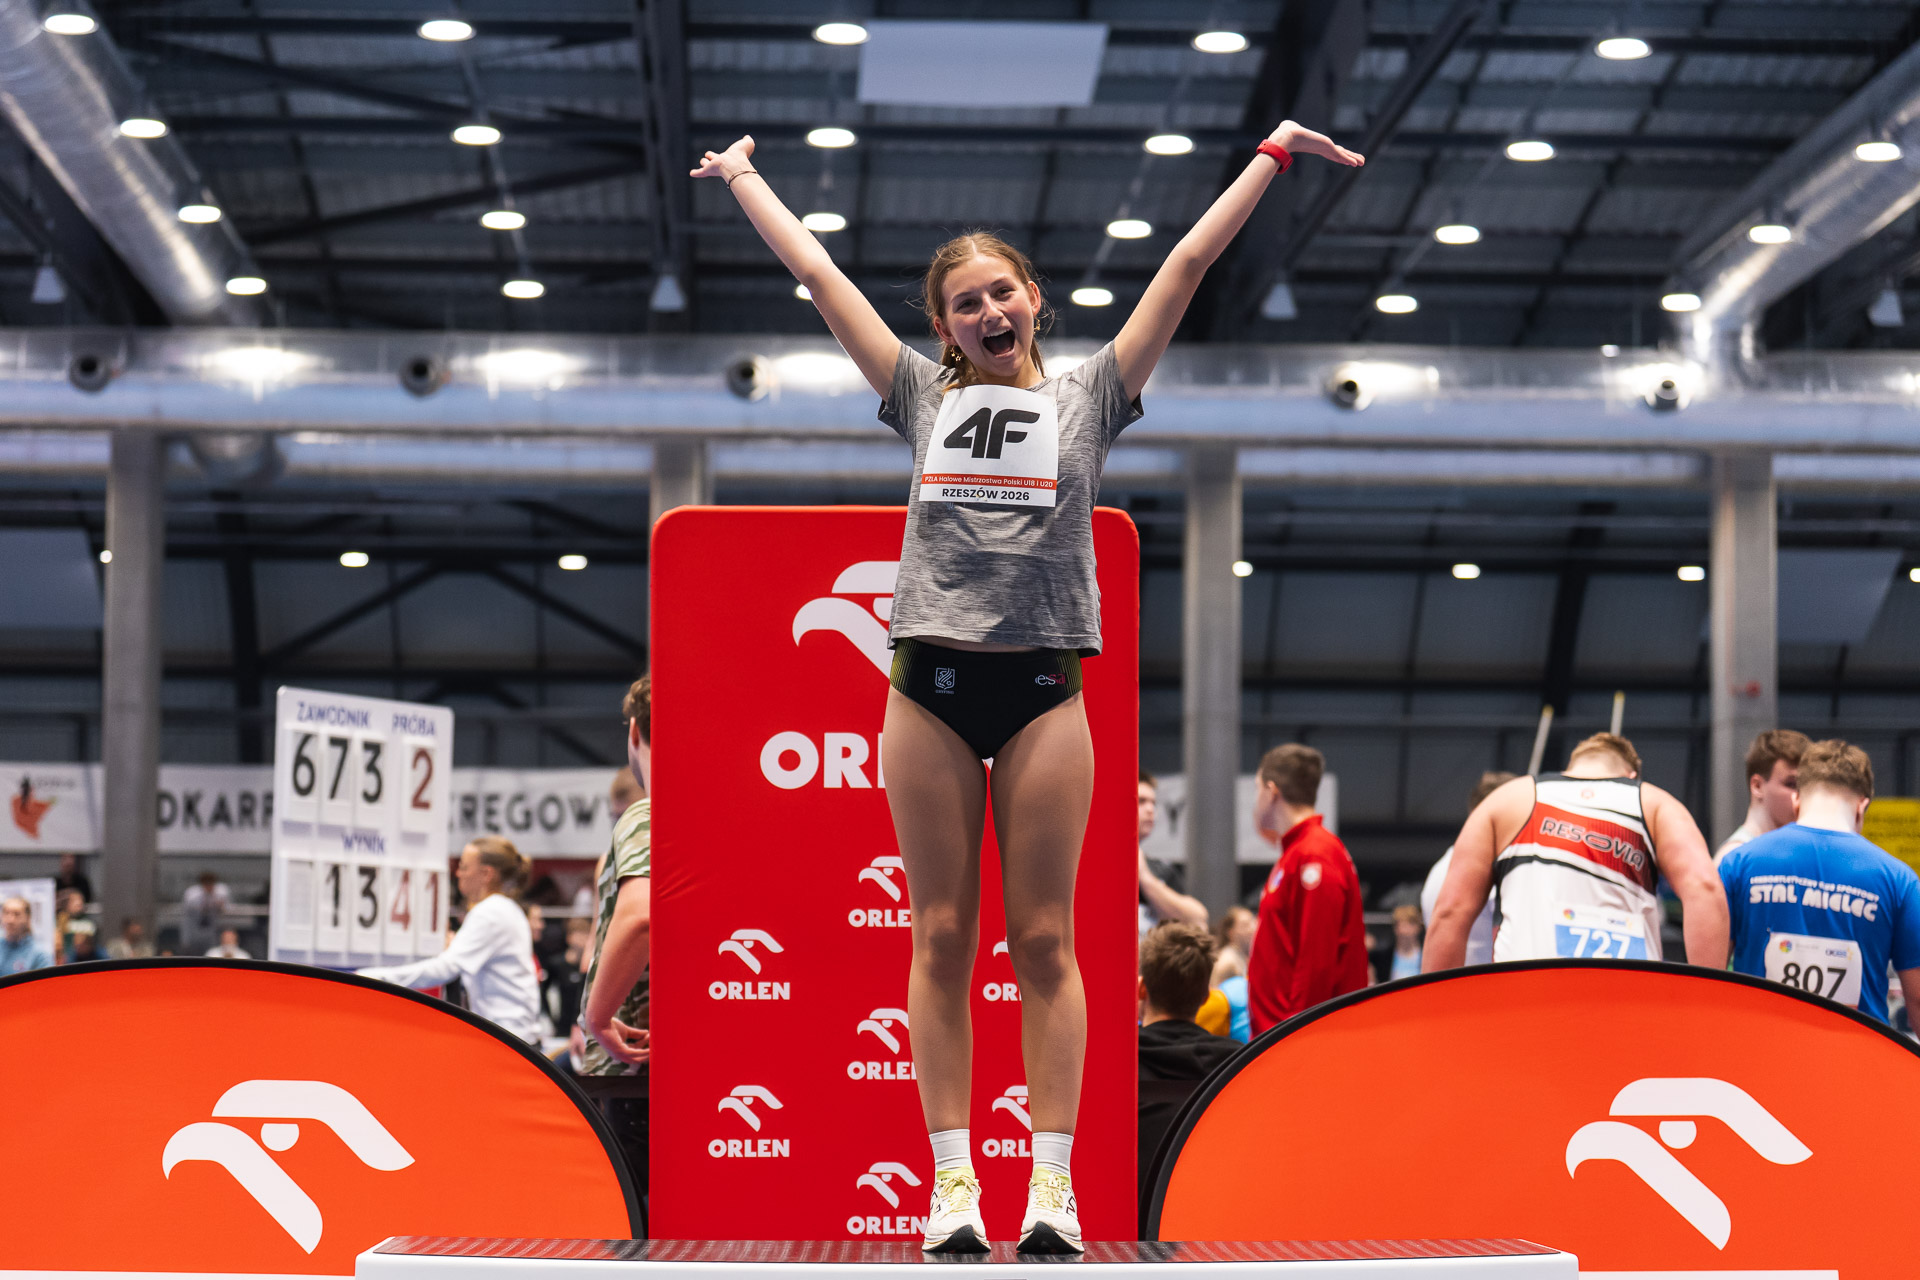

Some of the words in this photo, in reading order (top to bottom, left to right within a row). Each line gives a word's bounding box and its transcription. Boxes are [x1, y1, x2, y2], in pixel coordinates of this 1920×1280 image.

[943, 407, 1040, 460] 4F
[1003, 478, 1023, 486] Polski
[942, 487, 998, 499] RZESZÓW
[1001, 490, 1030, 501] 2026
[760, 731, 886, 789] OR
[412, 747, 433, 810] 2
[342, 834, 386, 853] WYNIK
[1540, 816, 1645, 871] RESOVIA
[1749, 884, 1797, 904] STAL
[848, 909, 912, 928] ORLE
[1569, 927, 1631, 960] 727
[709, 981, 790, 1000] ORLEN
[1781, 962, 1847, 1000] 807
[983, 982, 1022, 1001] OR
[708, 1138, 790, 1158] ORLEN
[982, 1138, 1032, 1158] ORL
[846, 1216, 928, 1235] ORLEN
